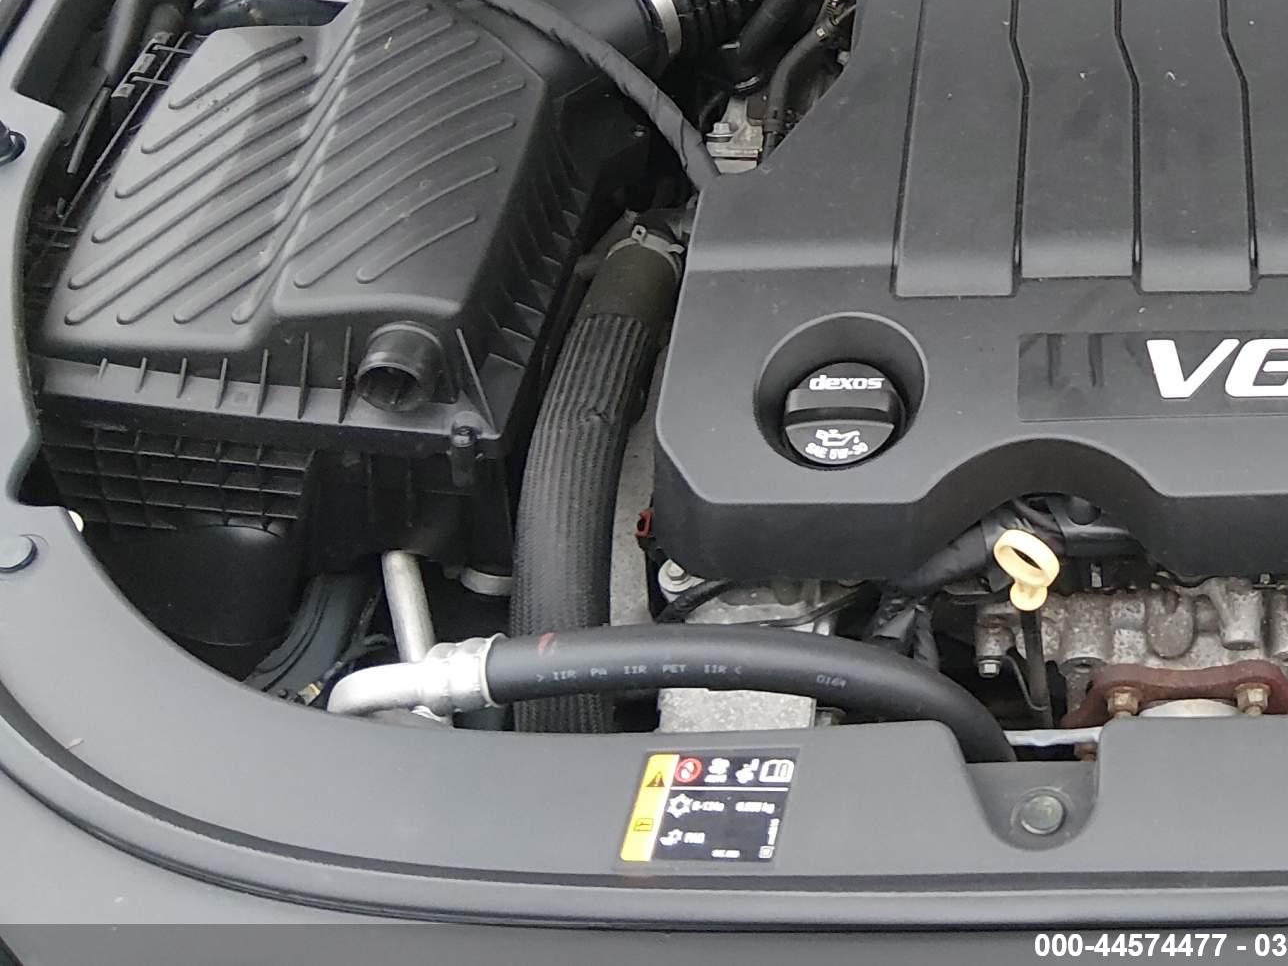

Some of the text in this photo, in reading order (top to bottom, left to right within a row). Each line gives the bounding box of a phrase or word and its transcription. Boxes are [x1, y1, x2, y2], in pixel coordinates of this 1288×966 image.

[808, 374, 885, 390] dexos
[623, 665, 648, 675] IIR
[662, 664, 687, 674] PET
